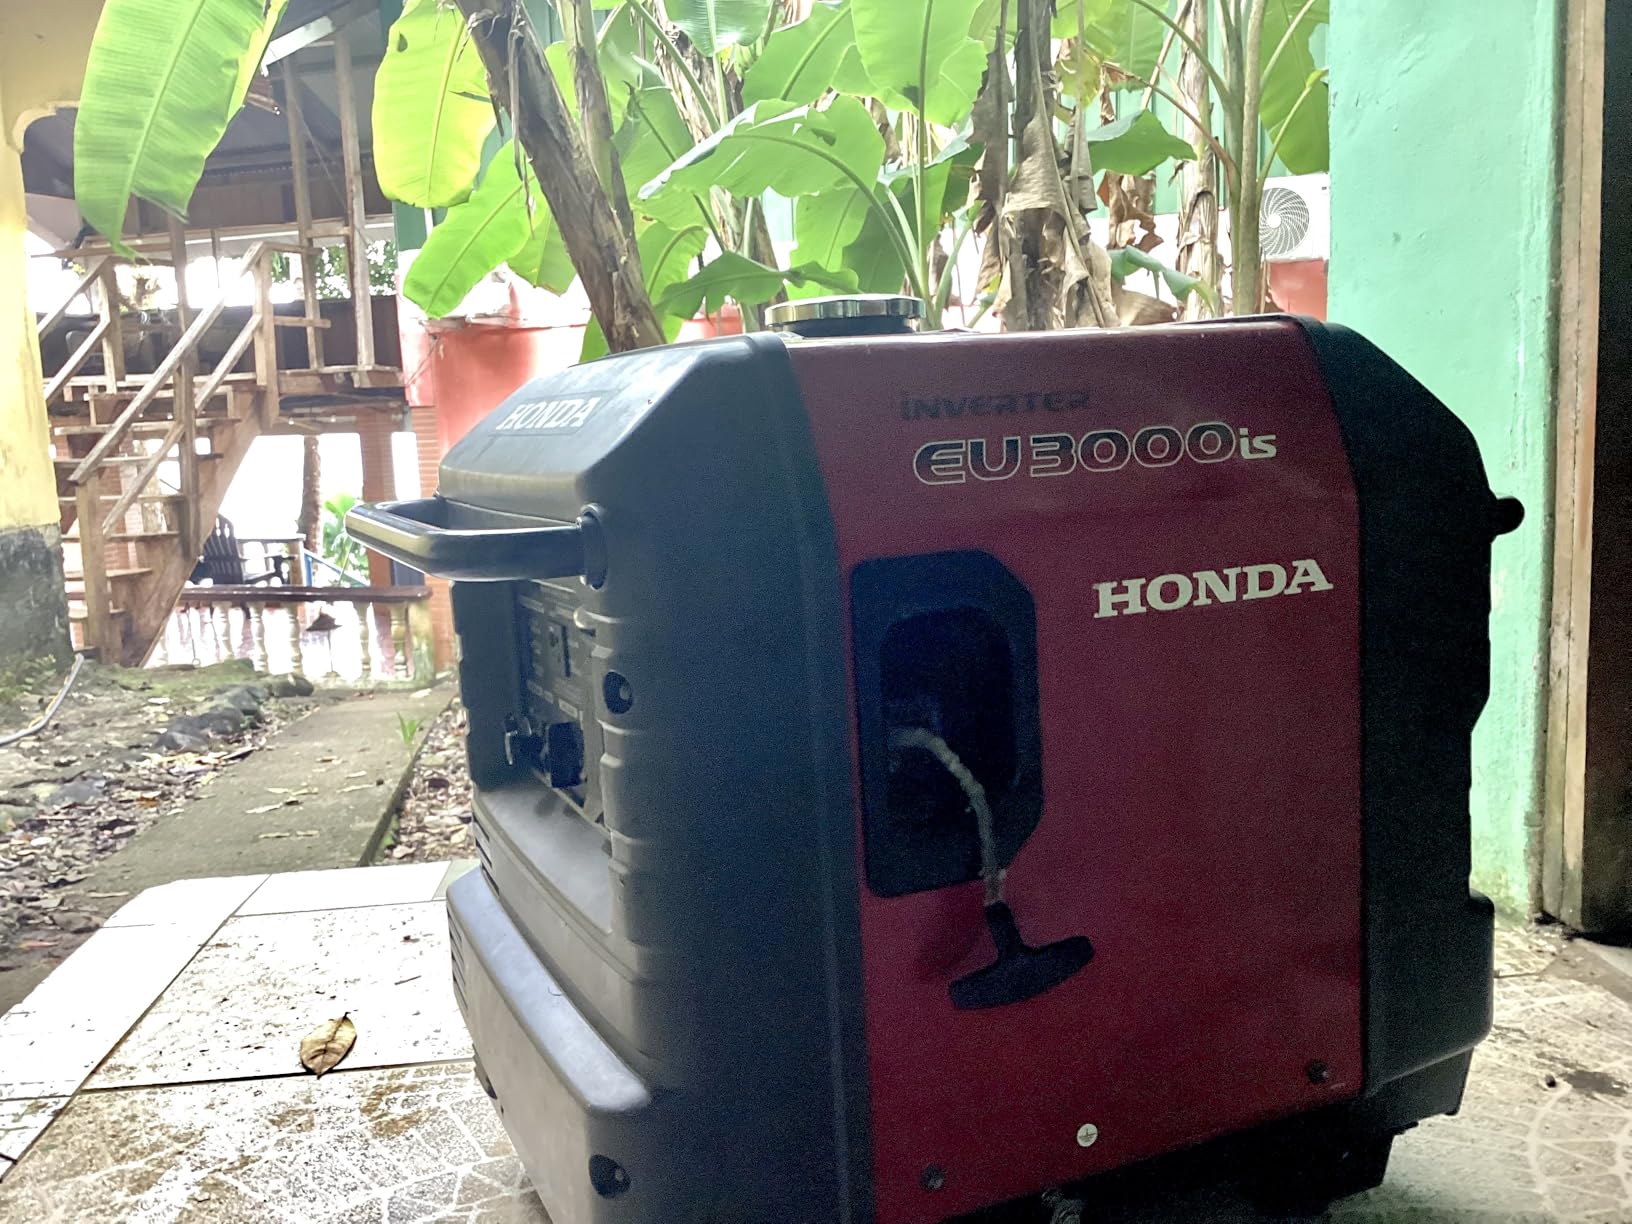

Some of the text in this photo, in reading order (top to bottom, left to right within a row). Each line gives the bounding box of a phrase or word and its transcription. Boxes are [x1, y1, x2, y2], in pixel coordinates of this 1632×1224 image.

[496, 397, 601, 430] HONDA
[902, 391, 1088, 419] INVERTER
[1092, 558, 1334, 619] HONDA
